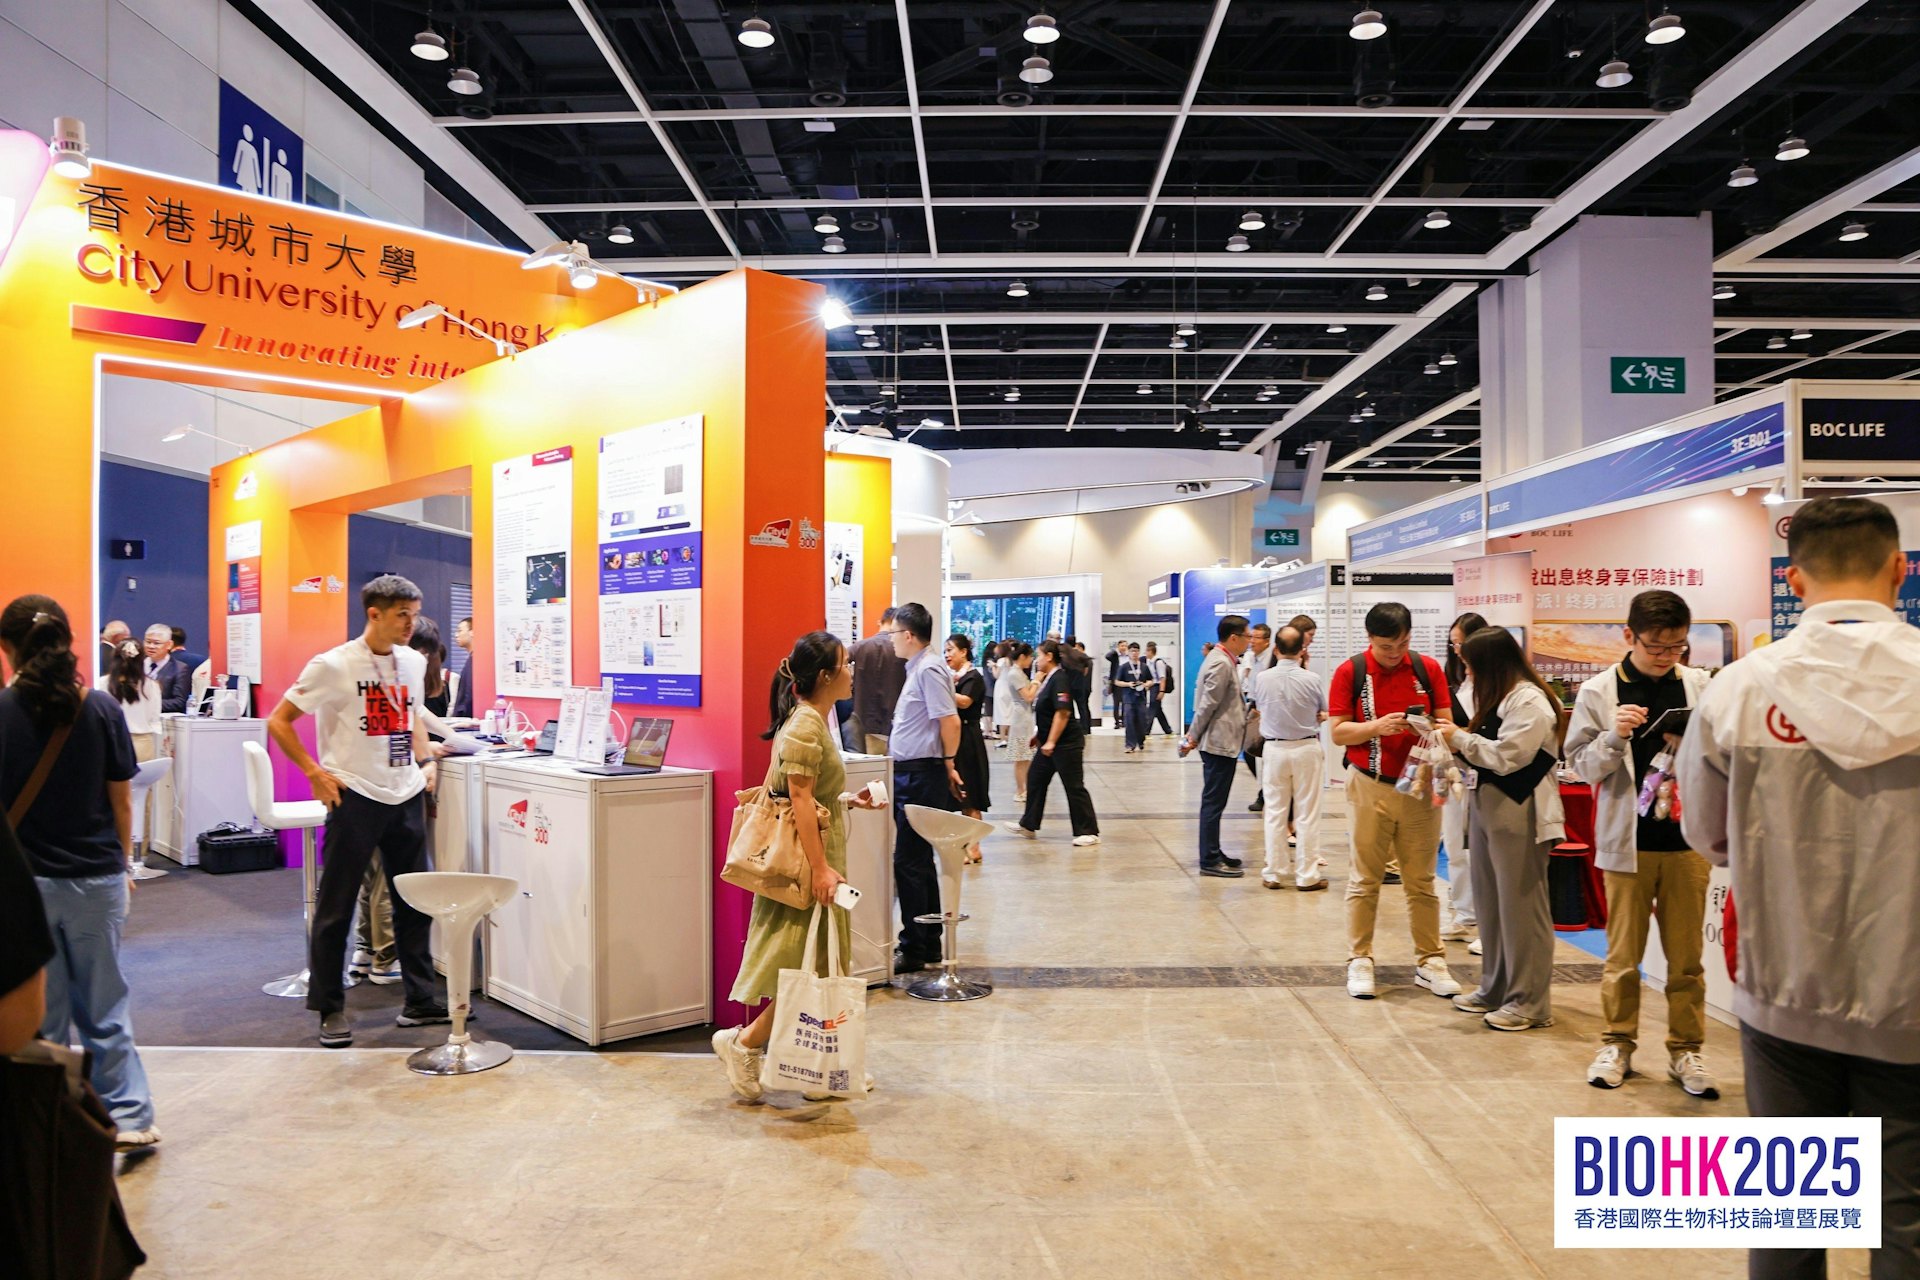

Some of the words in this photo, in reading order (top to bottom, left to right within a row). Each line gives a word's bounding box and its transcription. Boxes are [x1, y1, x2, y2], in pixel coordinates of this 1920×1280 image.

[77, 183, 417, 286] 香港城市大學
[77, 243, 174, 294] City
[184, 262, 394, 329] University
[213, 326, 400, 378] Innovating
[1731, 430, 1771, 454] 3E-B01
[1810, 423, 1846, 437] BOC
[1849, 423, 1885, 437] LIFE
[357, 681, 384, 697] HK
[359, 716, 389, 731] 300
